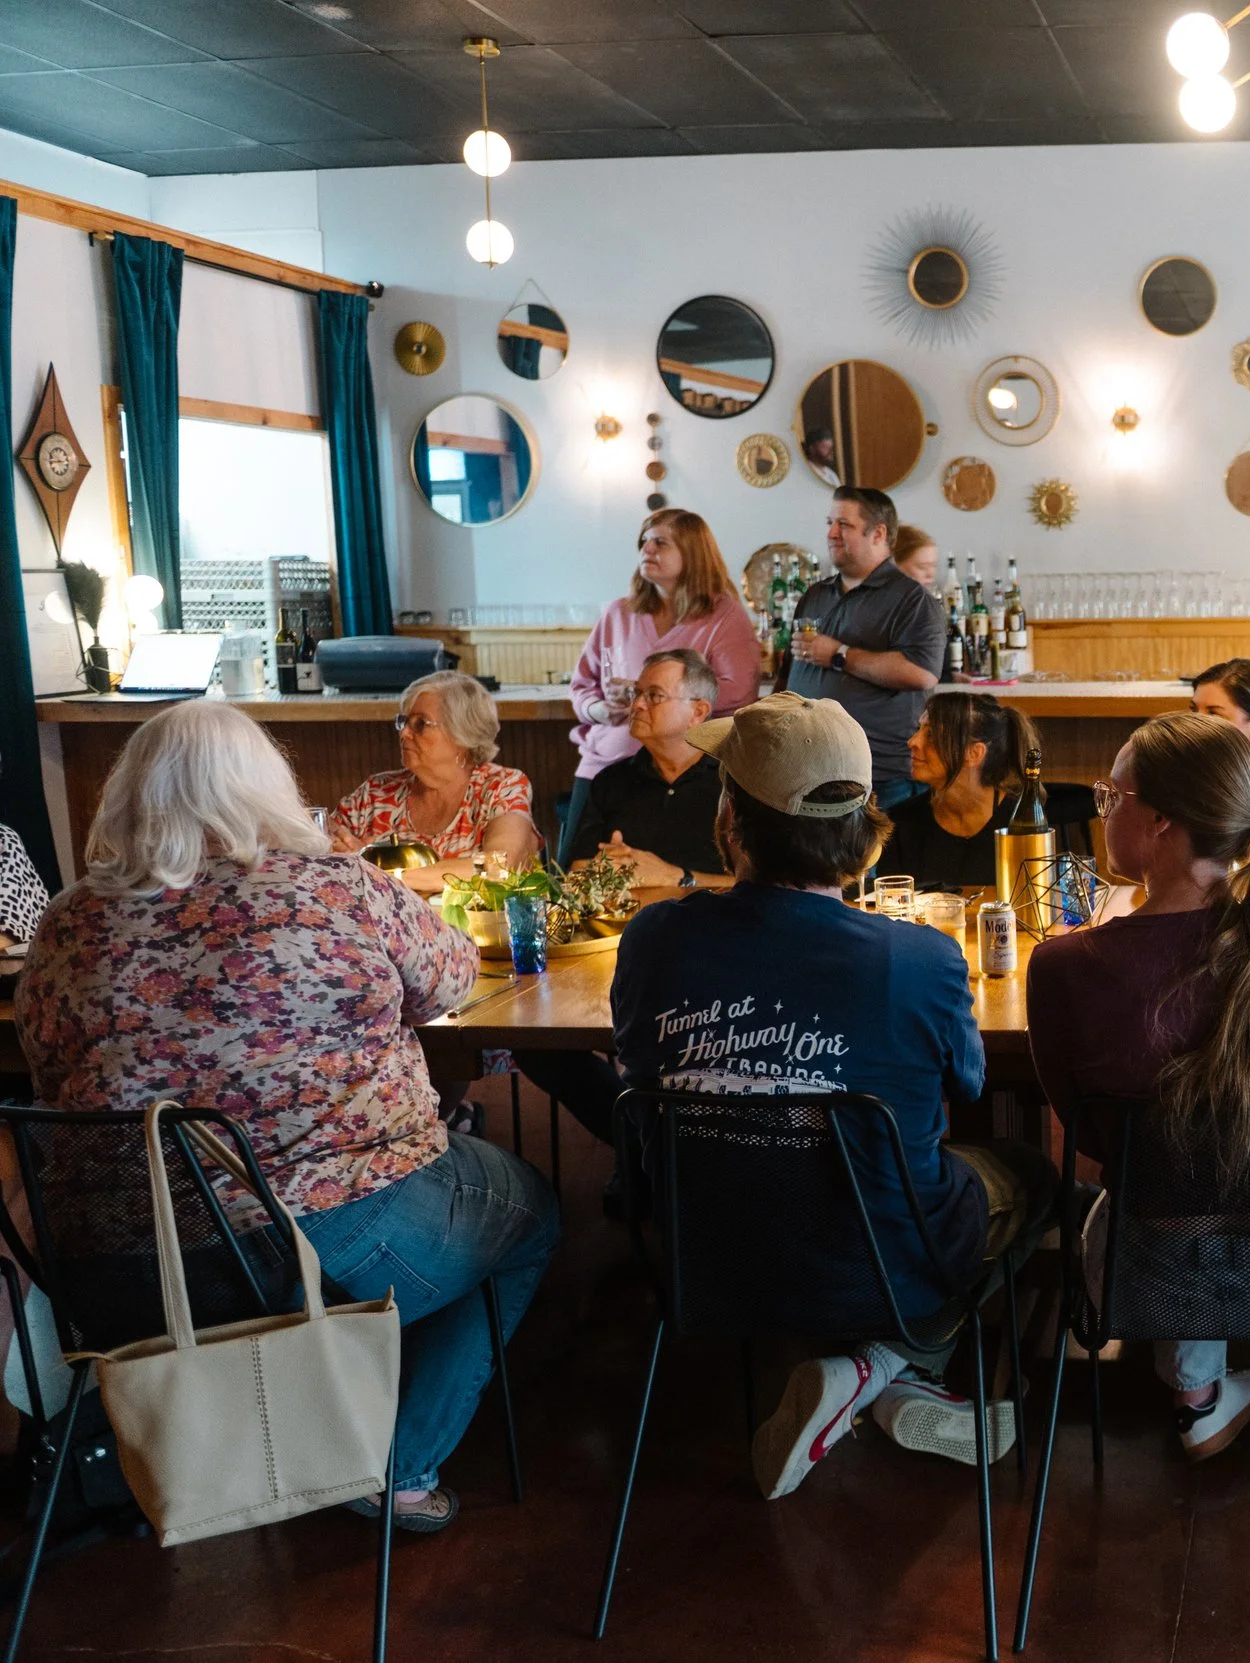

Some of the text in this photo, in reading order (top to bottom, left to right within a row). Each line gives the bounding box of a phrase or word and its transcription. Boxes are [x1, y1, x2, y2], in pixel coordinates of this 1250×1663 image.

[655, 995, 756, 1043] Tunnel at
[678, 1021, 849, 1068] Highway One
